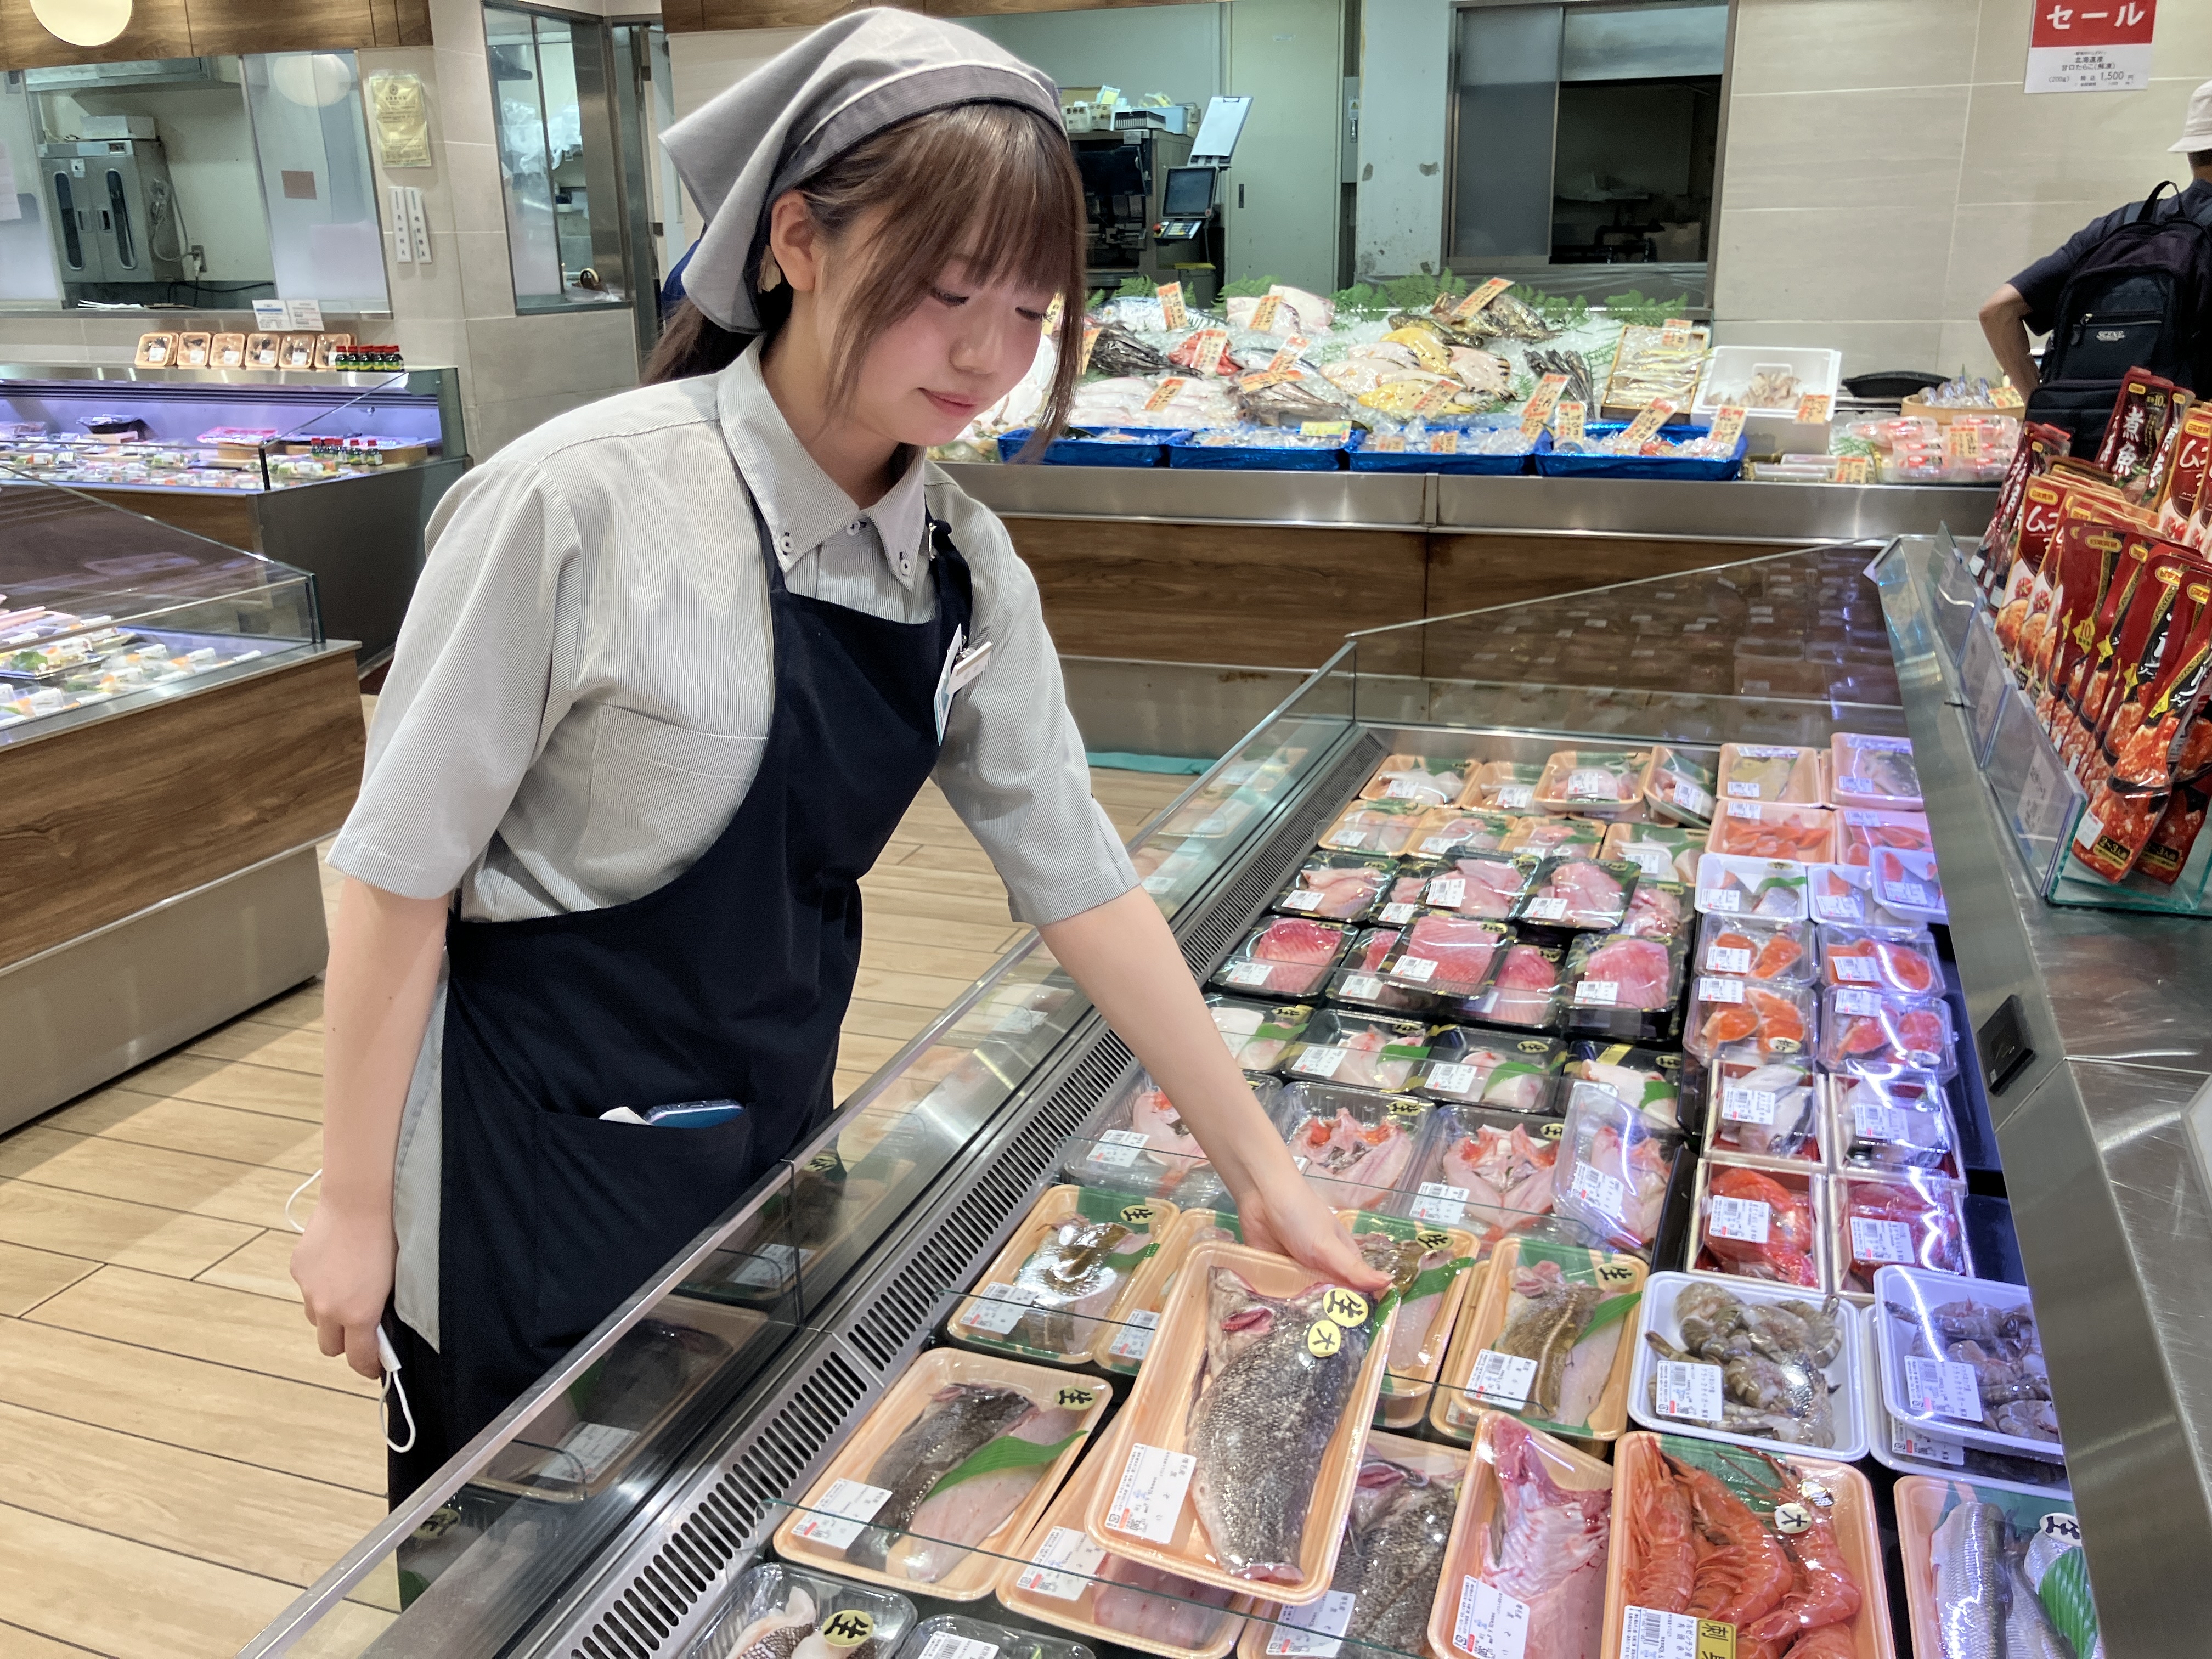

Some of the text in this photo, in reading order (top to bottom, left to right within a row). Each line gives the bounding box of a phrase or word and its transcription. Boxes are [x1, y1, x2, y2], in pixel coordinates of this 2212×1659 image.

[2047, 2, 2145, 30] セール
[1123, 1207, 1154, 1222] 生
[1417, 1234, 1448, 1249] 生
[1599, 1267, 1632, 1280] 生
[1326, 1290, 1364, 1318] 生
[1312, 1328, 1335, 1350] 大
[1059, 1389, 1093, 1405] 生
[1781, 1510, 1807, 1527] 大
[823, 1613, 870, 1639] 生
